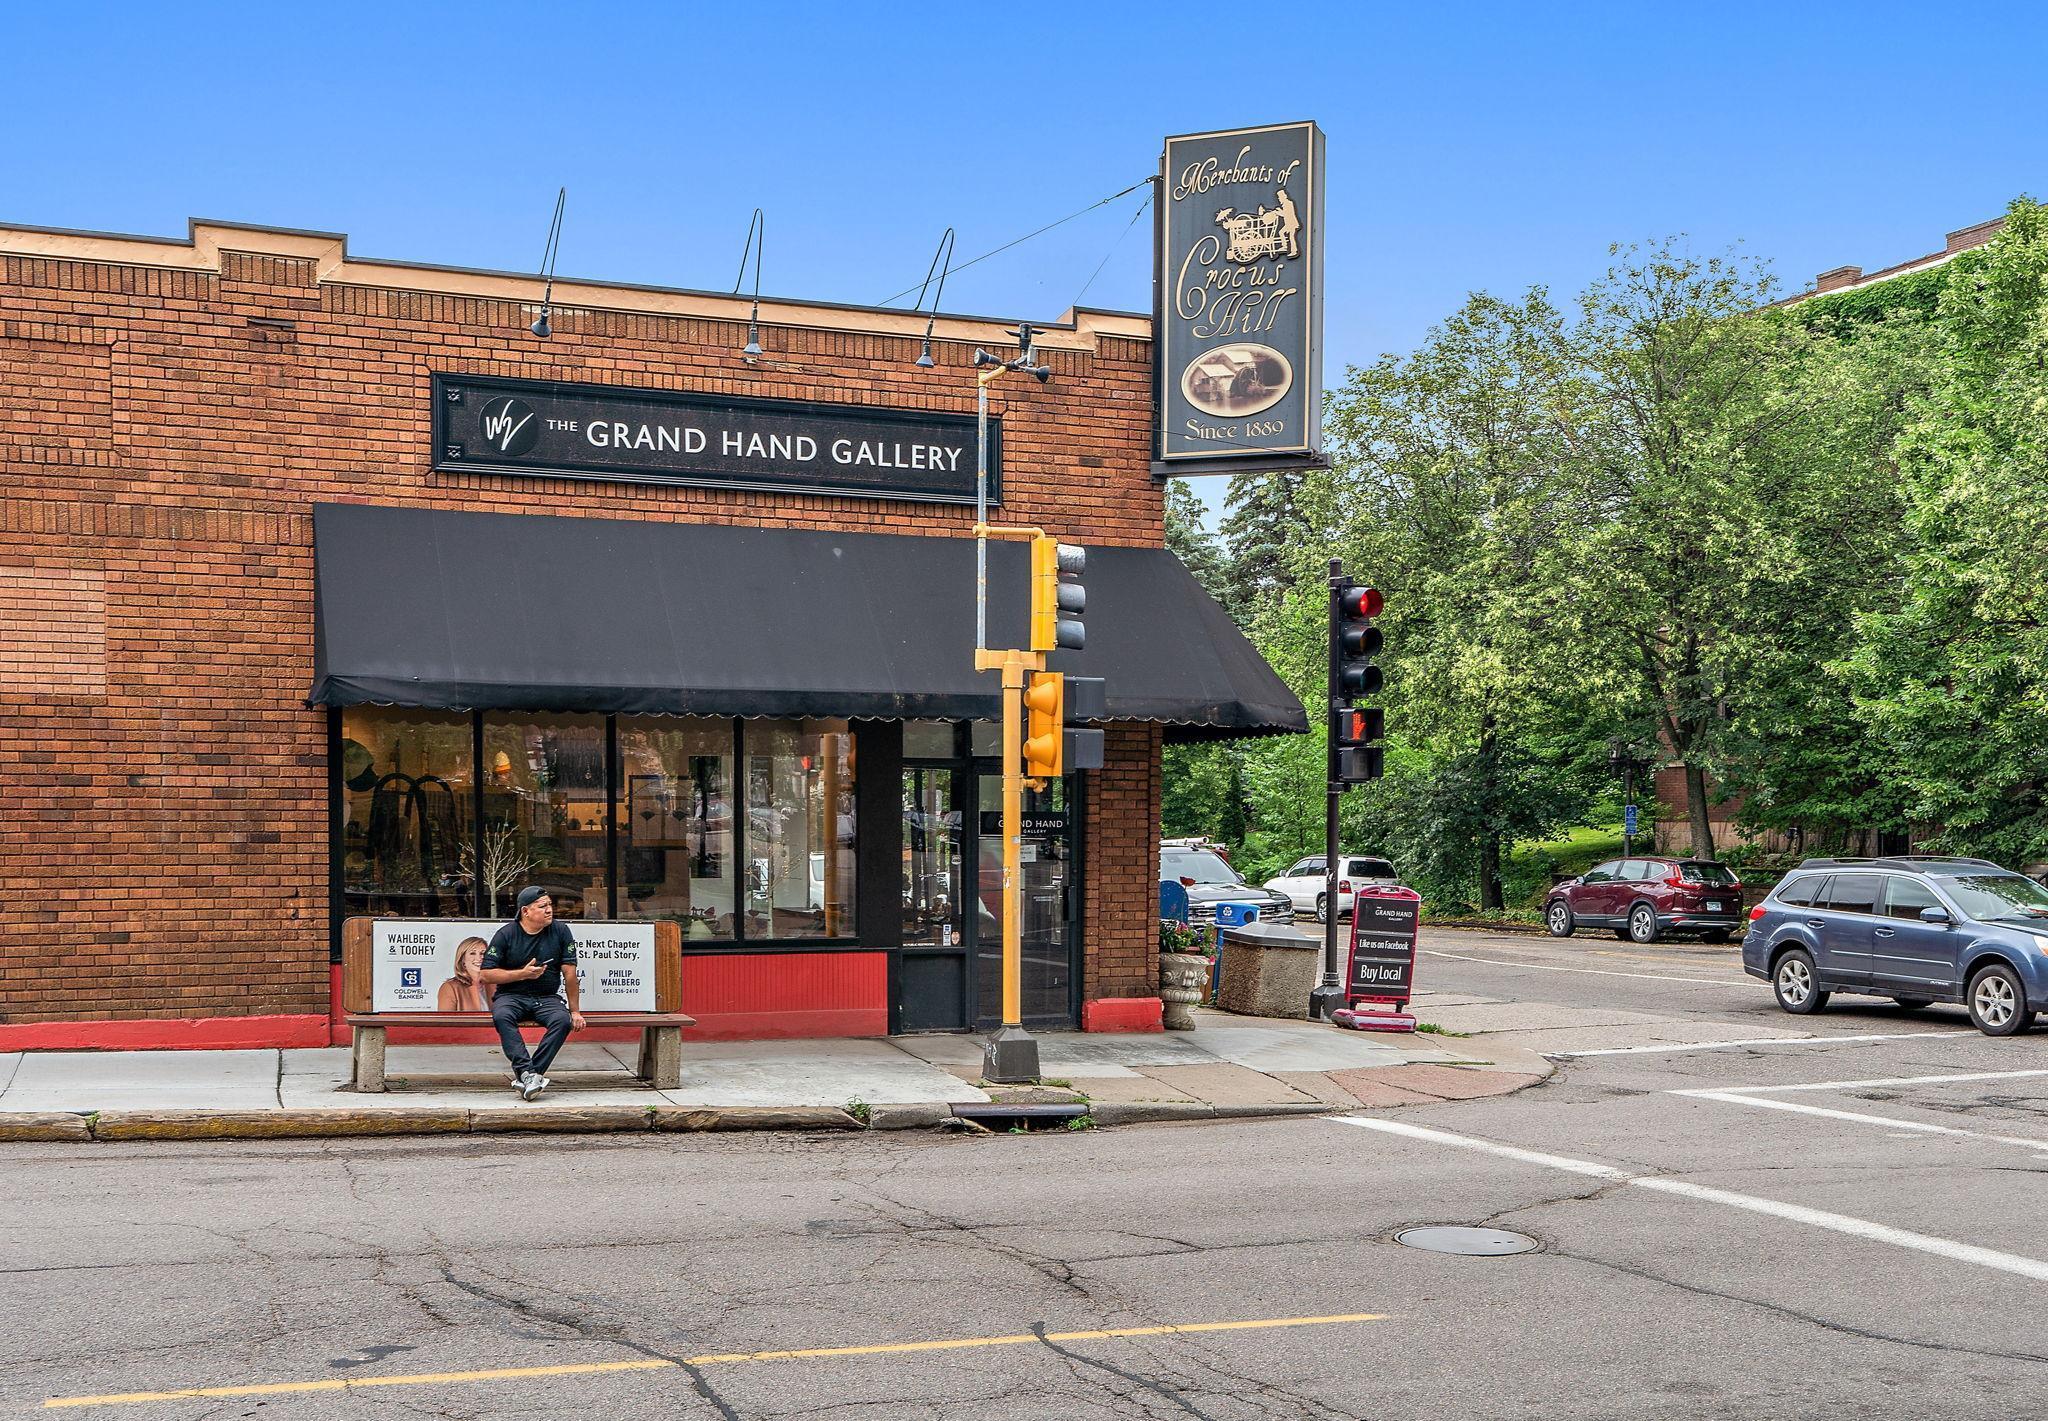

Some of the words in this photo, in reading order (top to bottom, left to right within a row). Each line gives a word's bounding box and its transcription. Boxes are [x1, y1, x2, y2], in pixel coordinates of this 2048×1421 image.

[1173, 145, 1274, 201] Merchants
[1277, 160, 1300, 187] of
[1175, 235, 1284, 320] Crocus
[1192, 288, 1297, 339] Hill
[1184, 418, 1237, 441] Since
[1245, 419, 1284, 437] 1889
[546, 419, 578, 432] THE
[586, 420, 707, 453] GRAND
[722, 431, 817, 462] HAND
[831, 438, 963, 471] GALLERY
[998, 820, 1033, 828] GND
[1035, 820, 1063, 828] HAND
[1375, 909, 1396, 917] GRAND
[387, 933, 436, 944] WAHLBERG
[389, 945, 396, 953] &
[400, 945, 436, 955] TOOHEY
[574, 940, 584, 948] he
[586, 940, 605, 948] Next
[607, 940, 640, 950] Chapter
[1359, 939, 1370, 948] Like
[1384, 940, 1409, 950] Facebook
[578, 950, 591, 959] St.
[593, 950, 612, 959] Paul
[614, 951, 640, 961] Story.
[608, 970, 633, 978] PHILIP
[1360, 964, 1378, 983] Buy
[1379, 965, 1402, 980] Local
[600, 978, 640, 986] WAHLBERG
